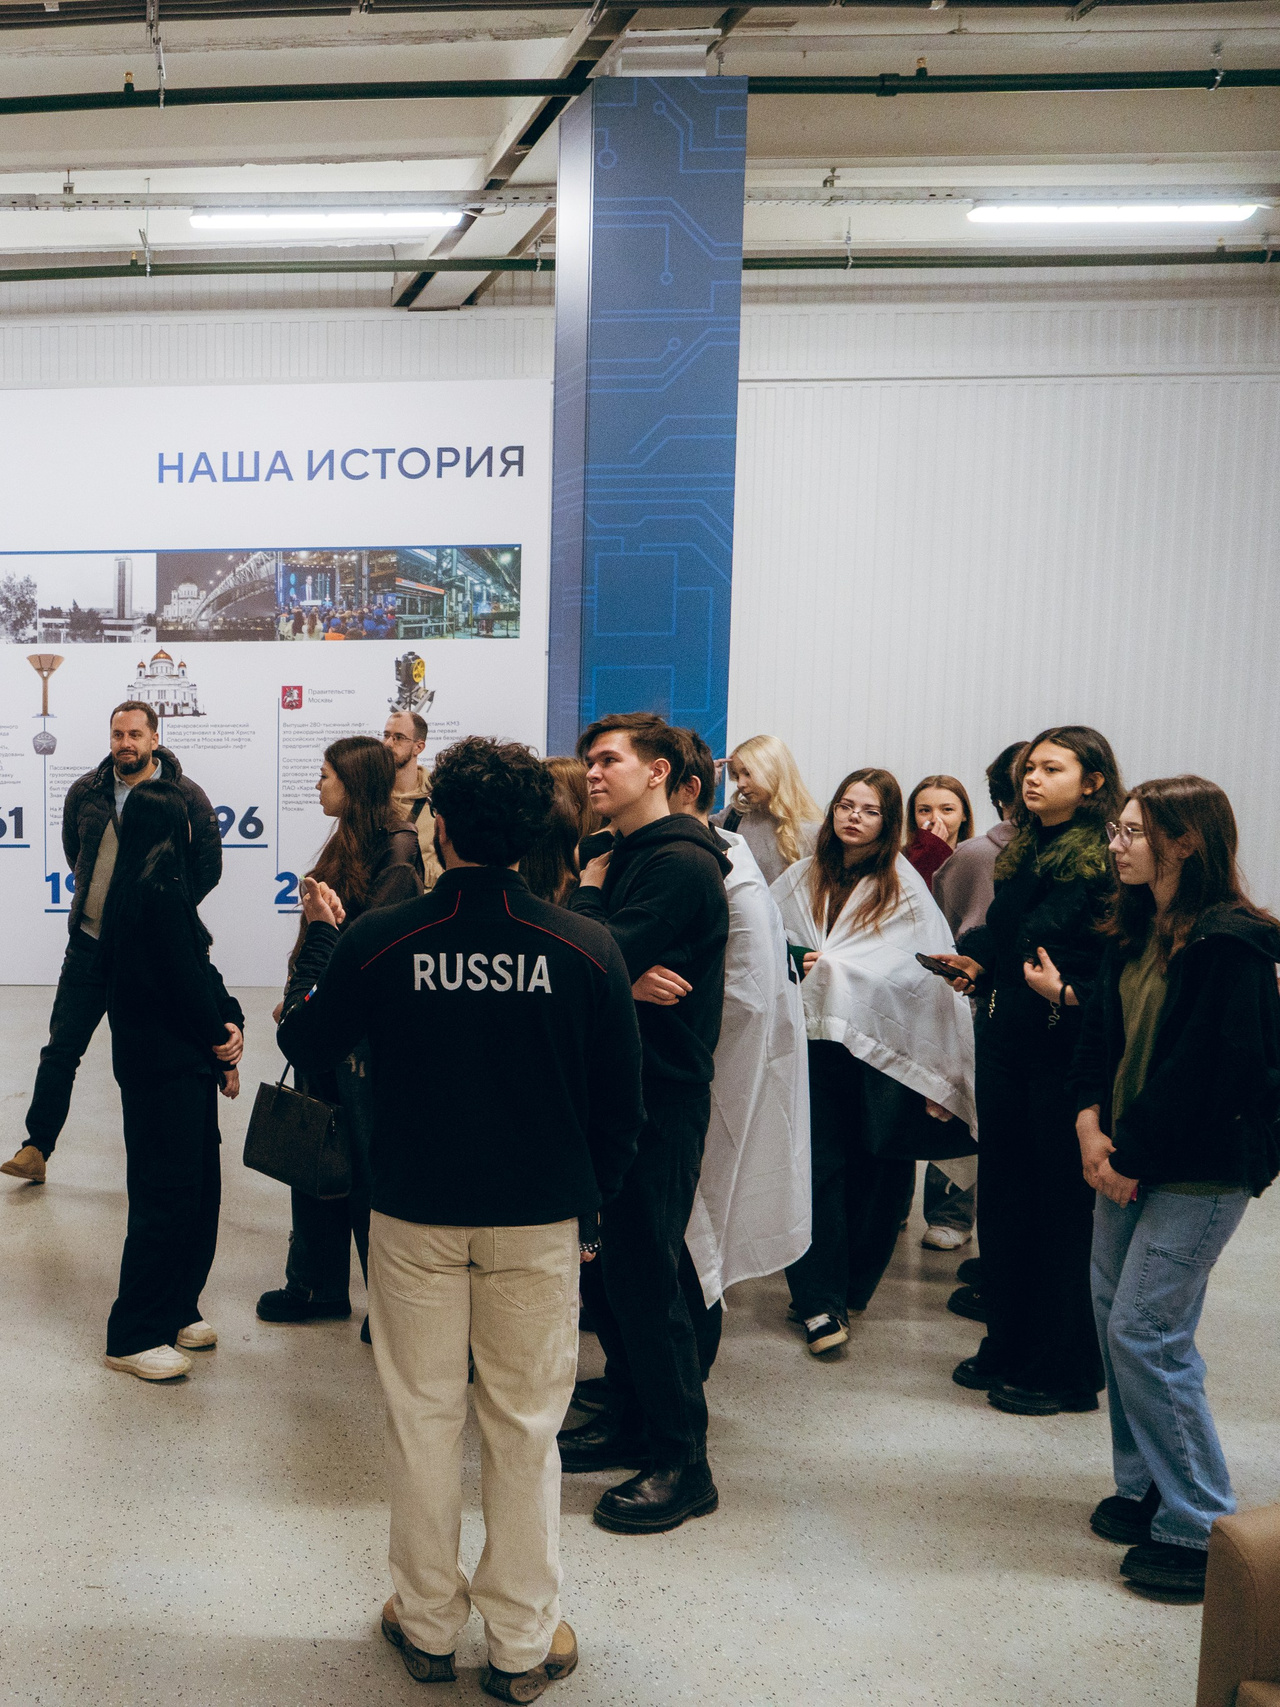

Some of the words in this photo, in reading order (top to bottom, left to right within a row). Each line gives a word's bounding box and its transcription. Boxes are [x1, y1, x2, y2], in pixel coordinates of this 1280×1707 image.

[158, 450, 294, 484] НАША
[307, 445, 524, 481] ИСТОРИЯ
[214, 805, 264, 840] 96
[274, 871, 298, 904] 2
[413, 952, 552, 994] RUSSIA
